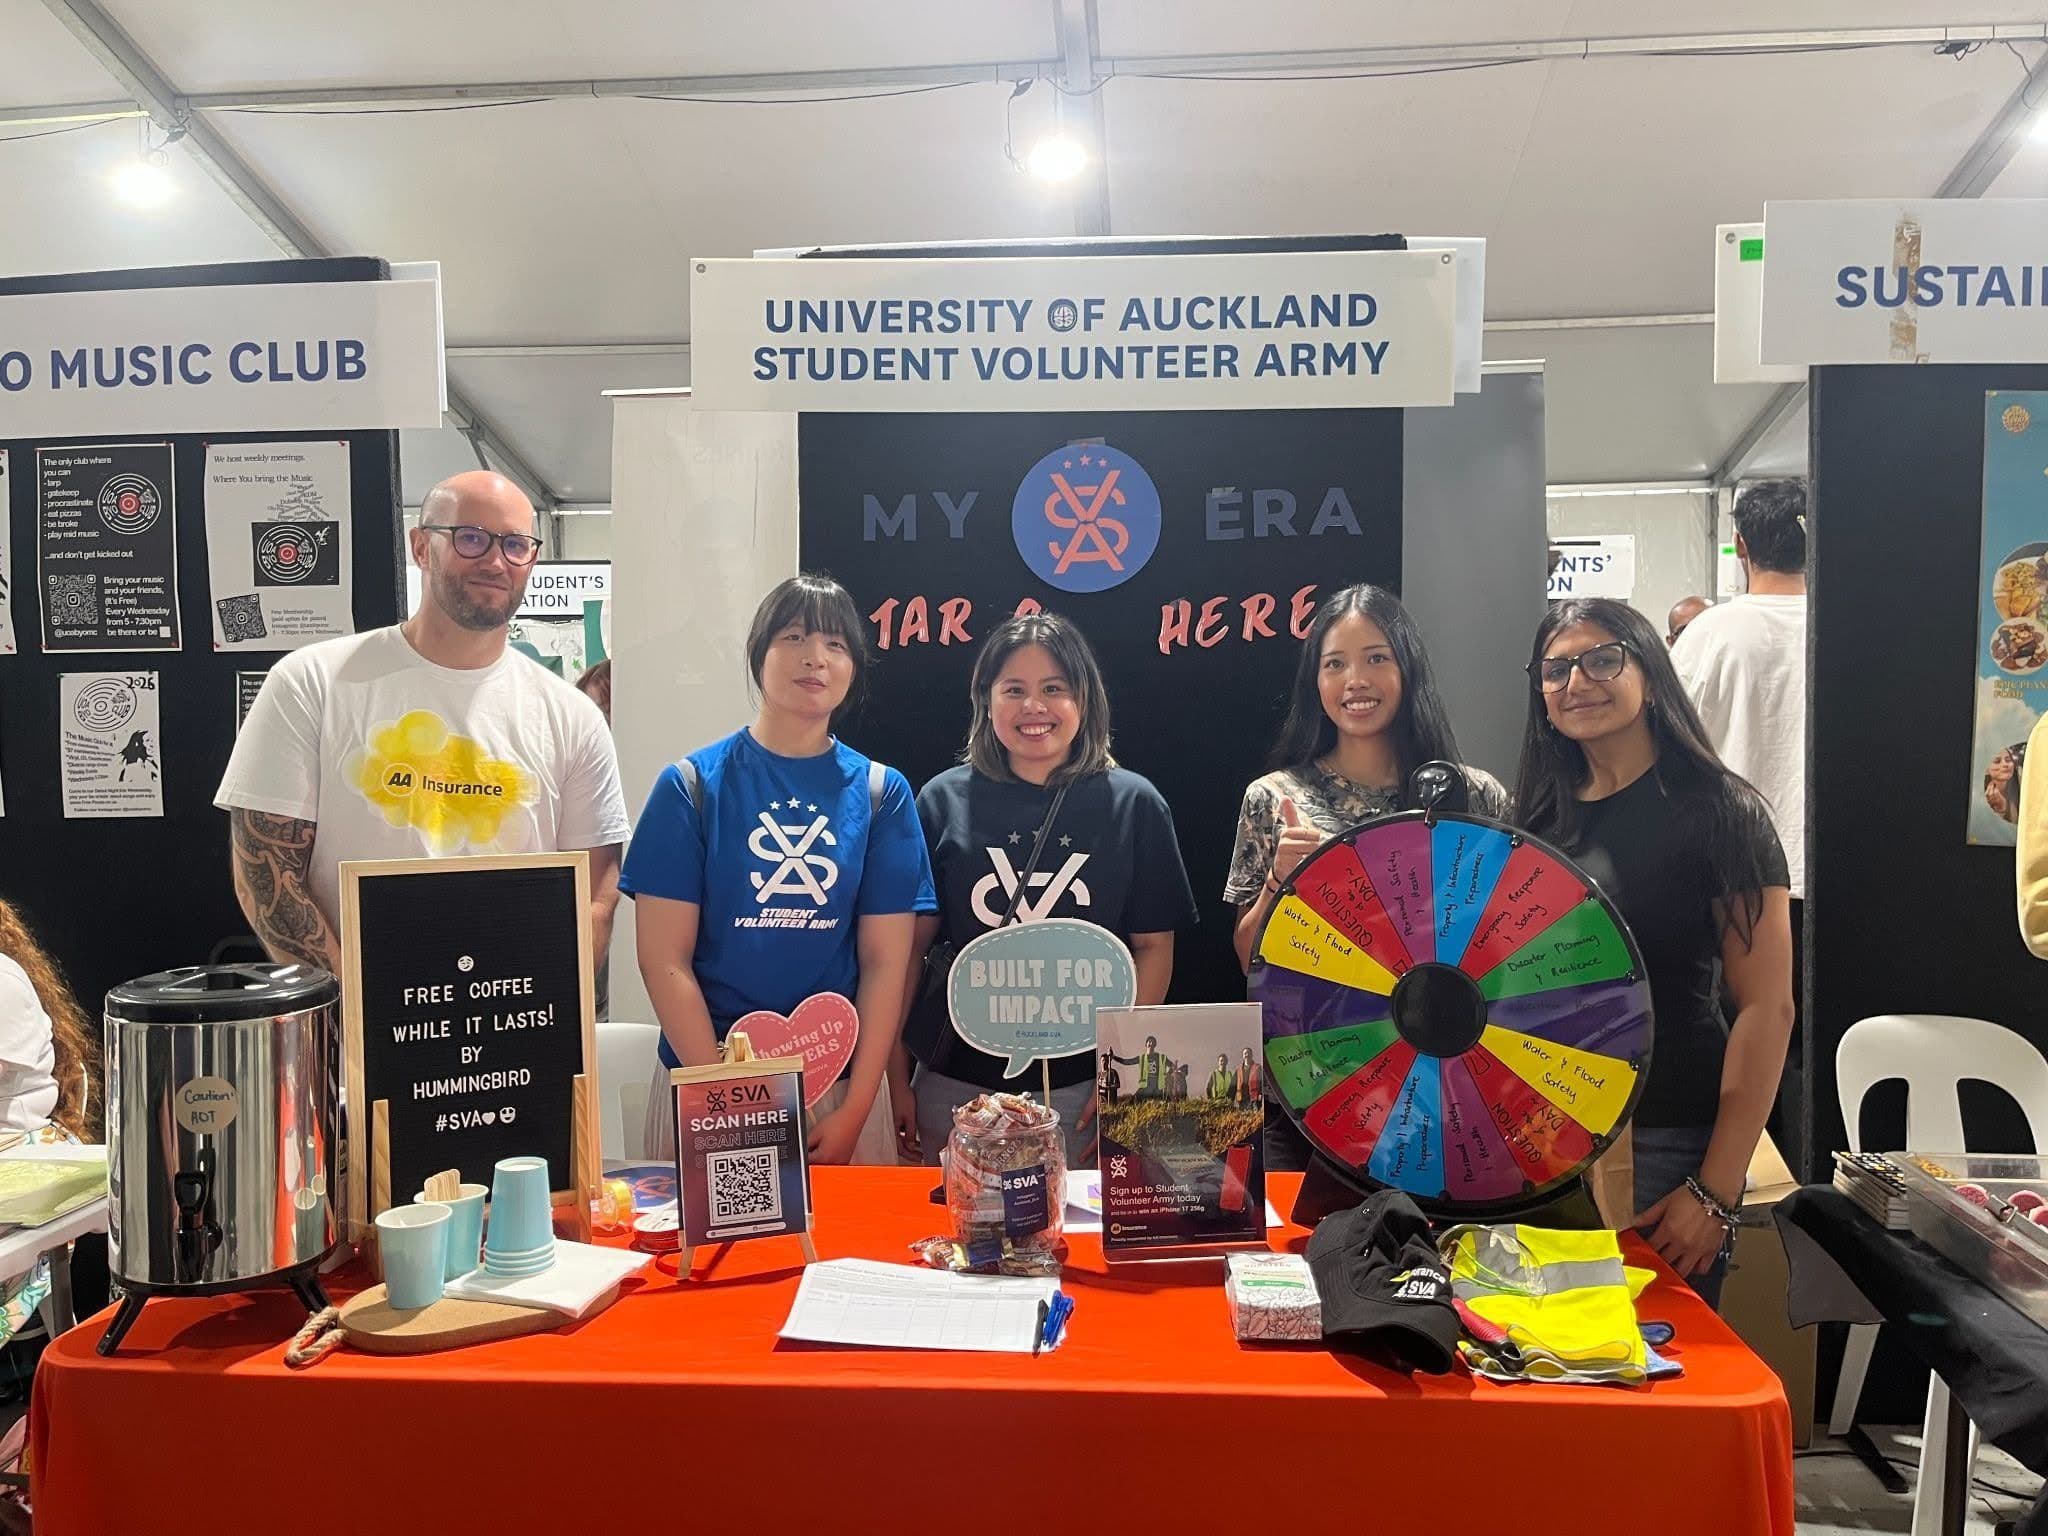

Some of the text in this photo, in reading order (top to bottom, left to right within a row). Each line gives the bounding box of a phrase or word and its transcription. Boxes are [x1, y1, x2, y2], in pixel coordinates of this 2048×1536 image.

[1835, 265, 2048, 308] SUSTAI
[765, 293, 1377, 333] UNIVERSITY OF AUCKLAND
[50, 343, 212, 390] MUSIC
[229, 339, 367, 383] CLUB
[753, 341, 1389, 381] STUDENT VOLUNTEER ARMY
[43, 458, 57, 466] The
[58, 458, 73, 467] only
[73, 457, 89, 465] club
[214, 455, 225, 463] We
[244, 454, 268, 463] weekly
[44, 470, 56, 478] you
[213, 475, 237, 483] Where
[255, 475, 275, 484] bring
[291, 474, 313, 482] Music
[47, 499, 94, 509] procrastinate
[58, 520, 79, 528] broke
[862, 487, 1363, 542] MY ERA
[47, 531, 62, 540] play
[64, 550, 83, 559] don't
[83, 552, 96, 560] get
[96, 550, 120, 558] kicked
[1562, 555, 1612, 573] NTS'
[103, 576, 123, 585] Bring
[124, 577, 140, 585] your
[532, 576, 604, 589] UDENT'S
[119, 587, 136, 595] your
[521, 594, 569, 607] ATION
[105, 607, 170, 616] Every Wednesday
[1158, 584, 1318, 655] HERE
[106, 618, 123, 626] from
[107, 628, 116, 636] be
[117, 628, 137, 636] there
[126, 676, 155, 690] 2026
[388, 772, 503, 796] AA Insurance
[760, 907, 817, 919] STUDENT
[1316, 882, 1373, 948] QUESTION
[1514, 903, 1548, 930] Safety
[734, 917, 839, 930] VOLUNTEER ARMY
[1284, 906, 1353, 957] Water Flood
[1473, 910, 1512, 950] Emergency
[1289, 936, 1321, 967] Safety
[1553, 935, 1600, 954] Planning
[970, 959, 1114, 988] BUILT FOR
[404, 978, 533, 1006] FREE COFFEE
[989, 995, 1093, 1024] IMPACT
[393, 1003, 554, 1043] WHILE IT LASTS!
[757, 1020, 843, 1059] howing Up
[461, 1046, 482, 1064] BY
[803, 1038, 840, 1062] ERS
[1522, 1039, 1606, 1090] Water Flood
[413, 1068, 531, 1100] HUMMINGBIRD
[731, 1084, 771, 1103] SVA
[1542, 1072, 1577, 1104] Safety
[191, 1110, 216, 1125] HOT
[435, 1109, 482, 1132] #SVA
[690, 1109, 789, 1132] SCAN HERE
[694, 1127, 787, 1151] SCAN HERE
[1491, 1102, 1542, 1164] QUESTION
[1013, 1174, 1039, 1189] SVA
[1110, 1186, 1129, 1197] Sign
[1132, 1187, 1142, 1195] up
[1155, 1184, 1189, 1193] Student
[1110, 1194, 1201, 1206] Volunteer Army today
[1408, 1280, 1436, 1296] SVA
